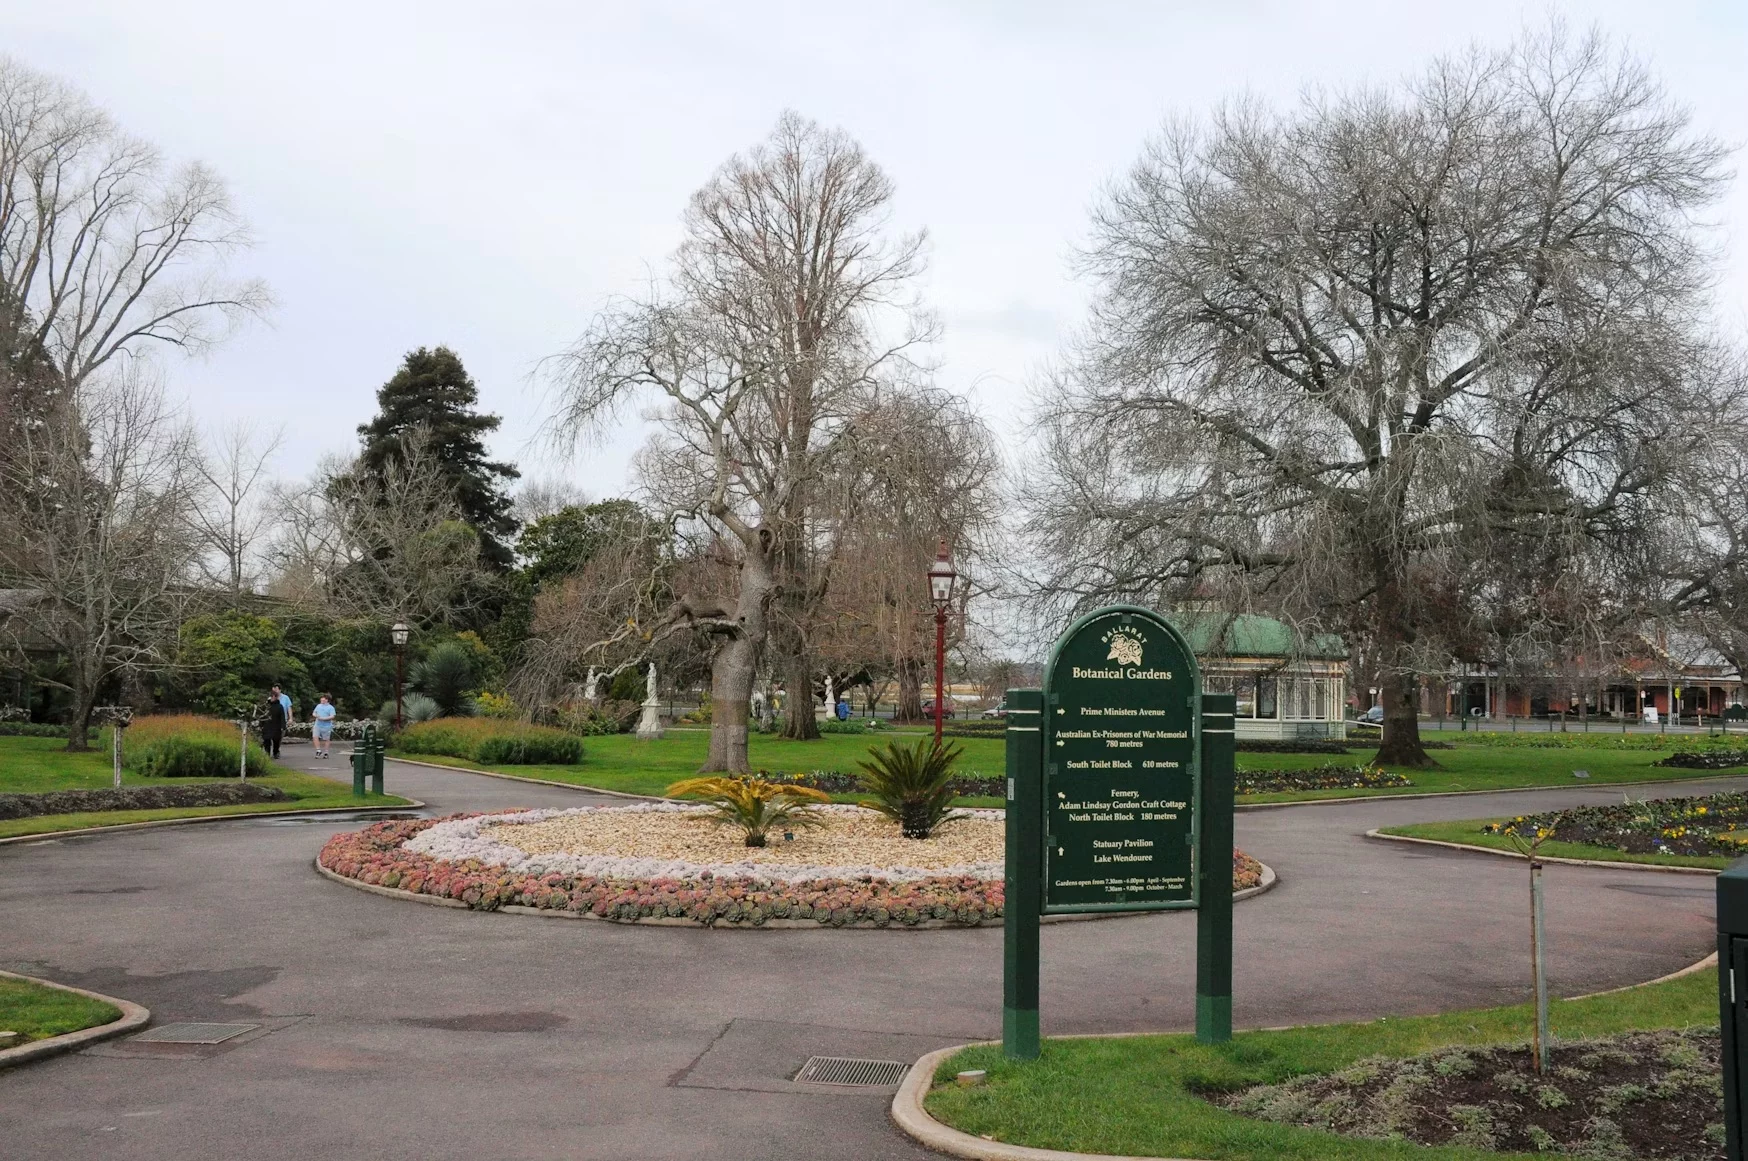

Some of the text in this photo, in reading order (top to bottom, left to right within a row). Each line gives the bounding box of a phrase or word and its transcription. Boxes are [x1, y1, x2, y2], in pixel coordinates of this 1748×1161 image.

[1101, 626, 1148, 644] BALLARAT
[1072, 667, 1172, 680] Botanical Gardens
[1080, 708, 1102, 716] Prime
[1104, 708, 1137, 716] Ministers
[1111, 789, 1140, 798] Fernery,
[1082, 802, 1111, 811] Lindsay
[1160, 801, 1186, 810] Cottage
[1093, 840, 1122, 849] Statuary
